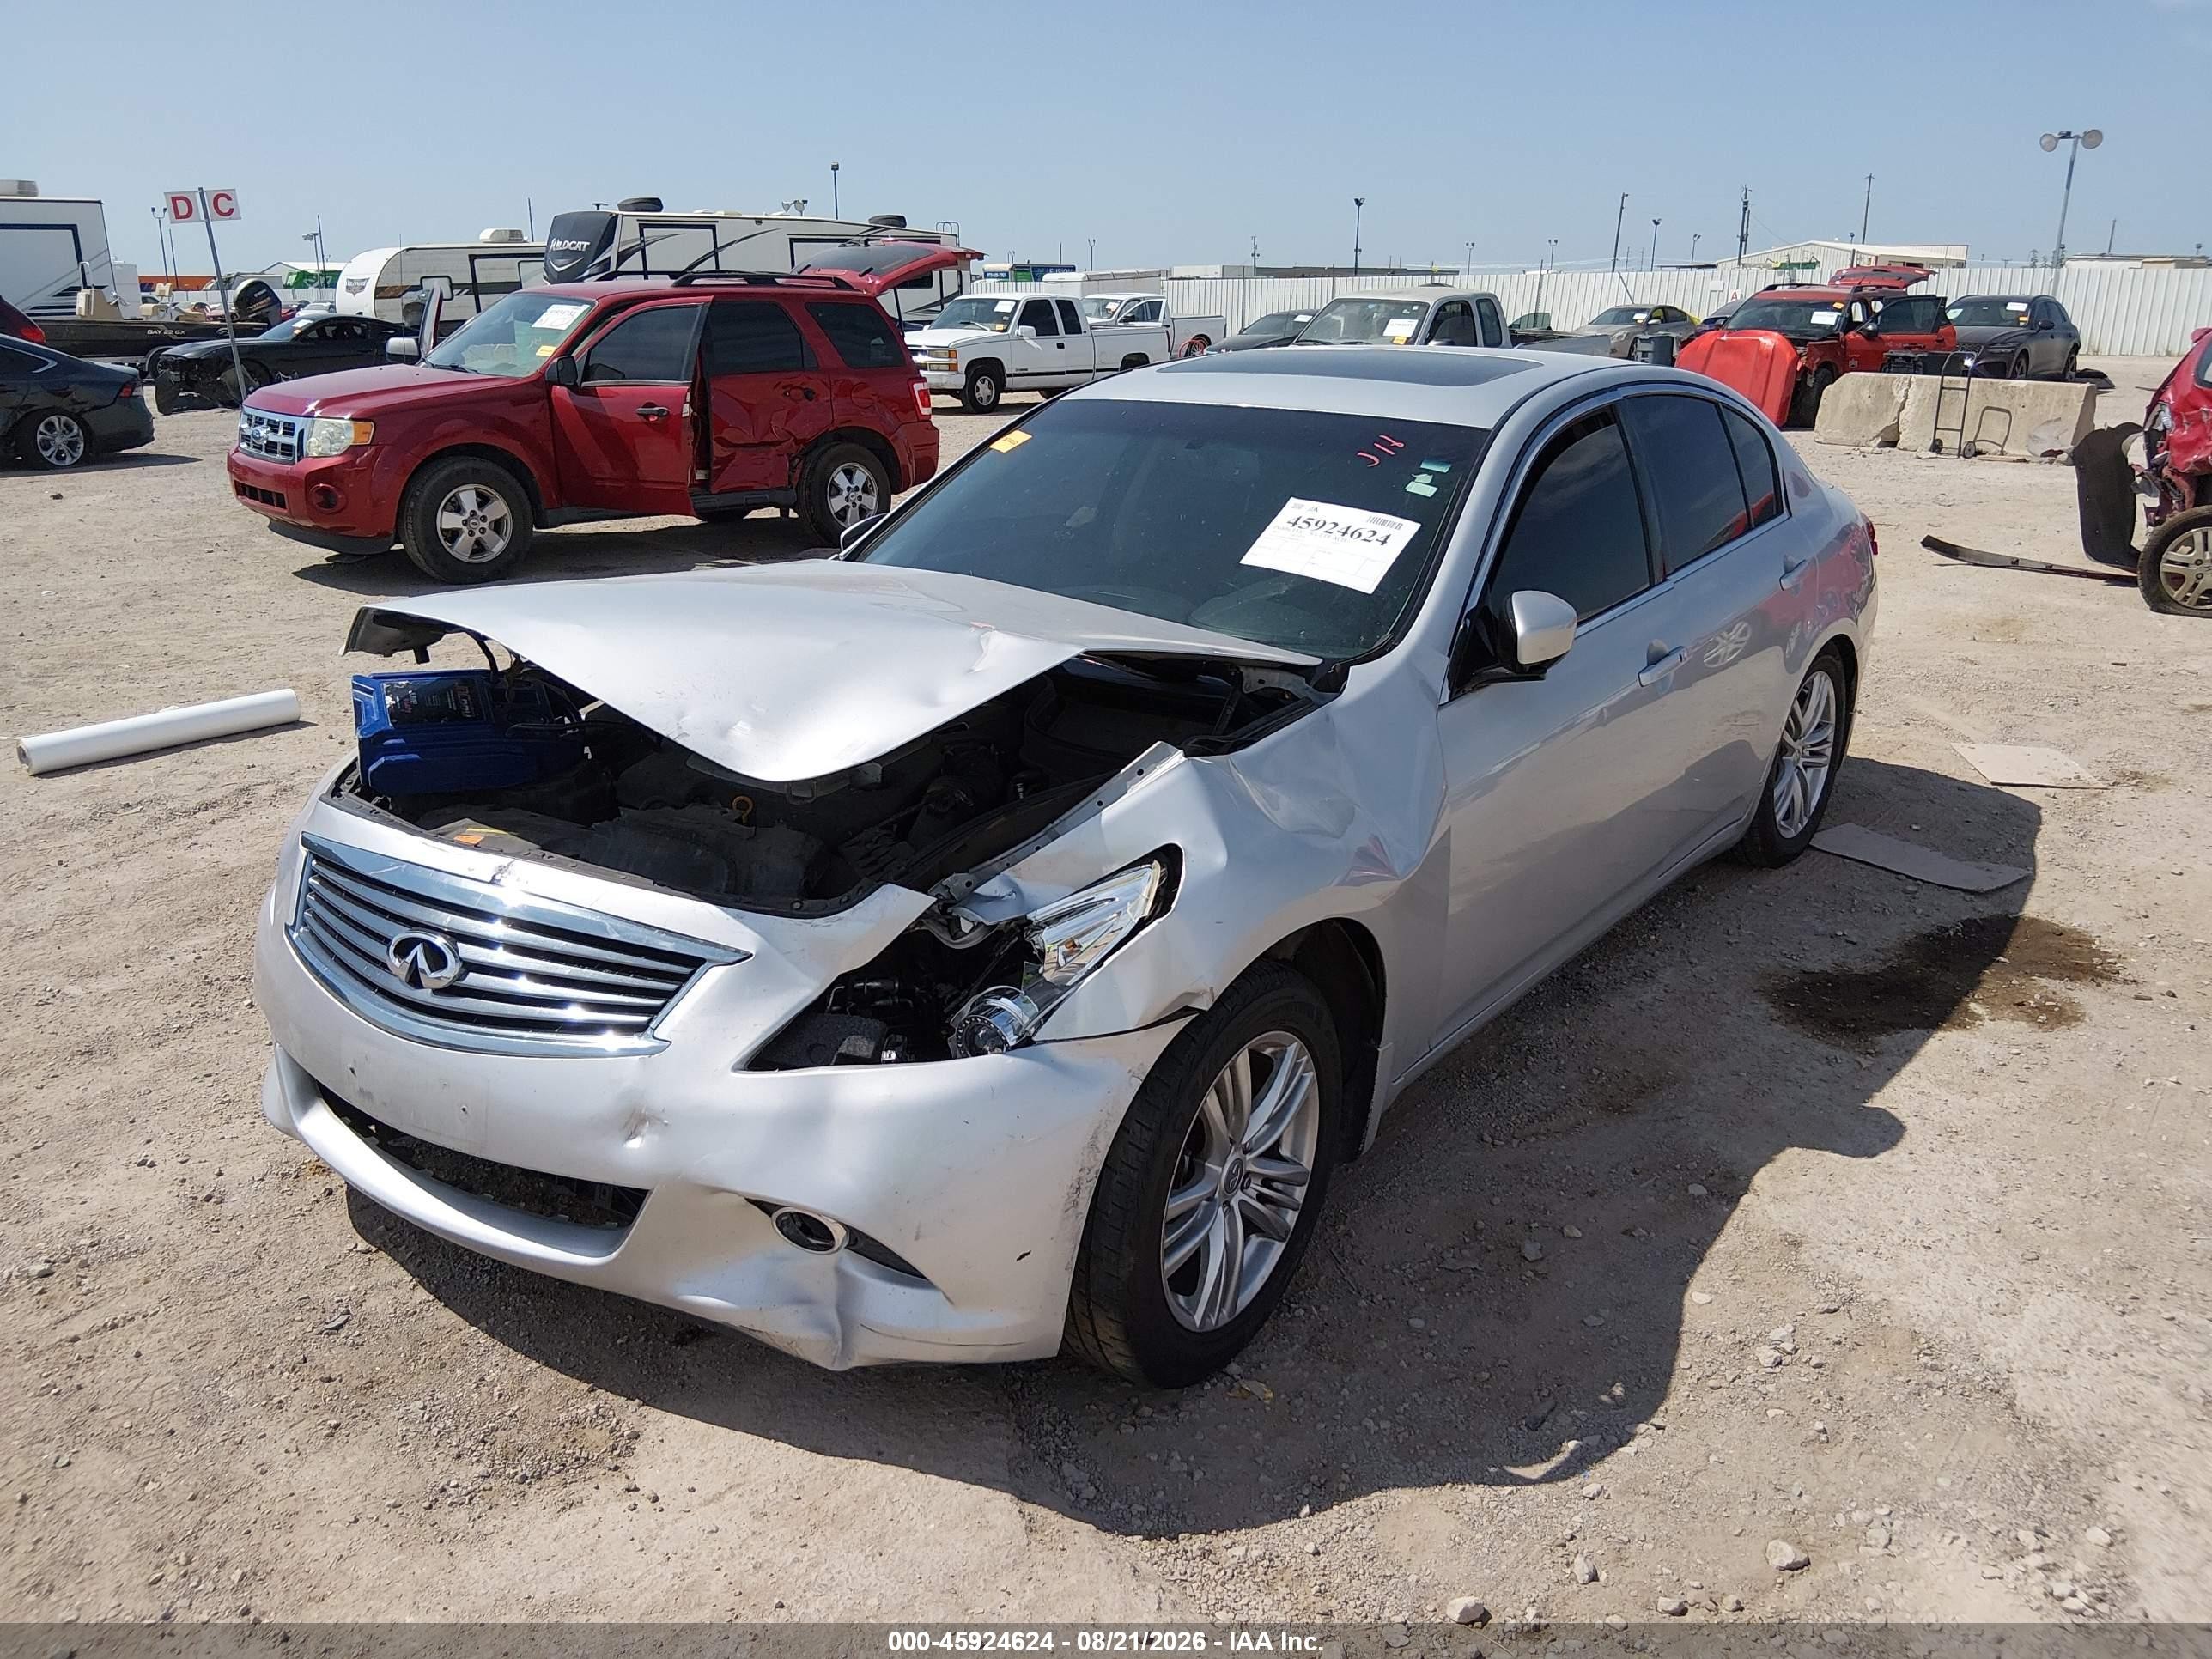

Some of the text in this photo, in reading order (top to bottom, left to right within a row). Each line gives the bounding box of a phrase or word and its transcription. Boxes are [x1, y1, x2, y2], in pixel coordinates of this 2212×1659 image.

[170, 195, 193, 219] D
[212, 192, 234, 217] C
[549, 237, 591, 253] WILDCAT
[1286, 515, 1392, 546] 45924624
